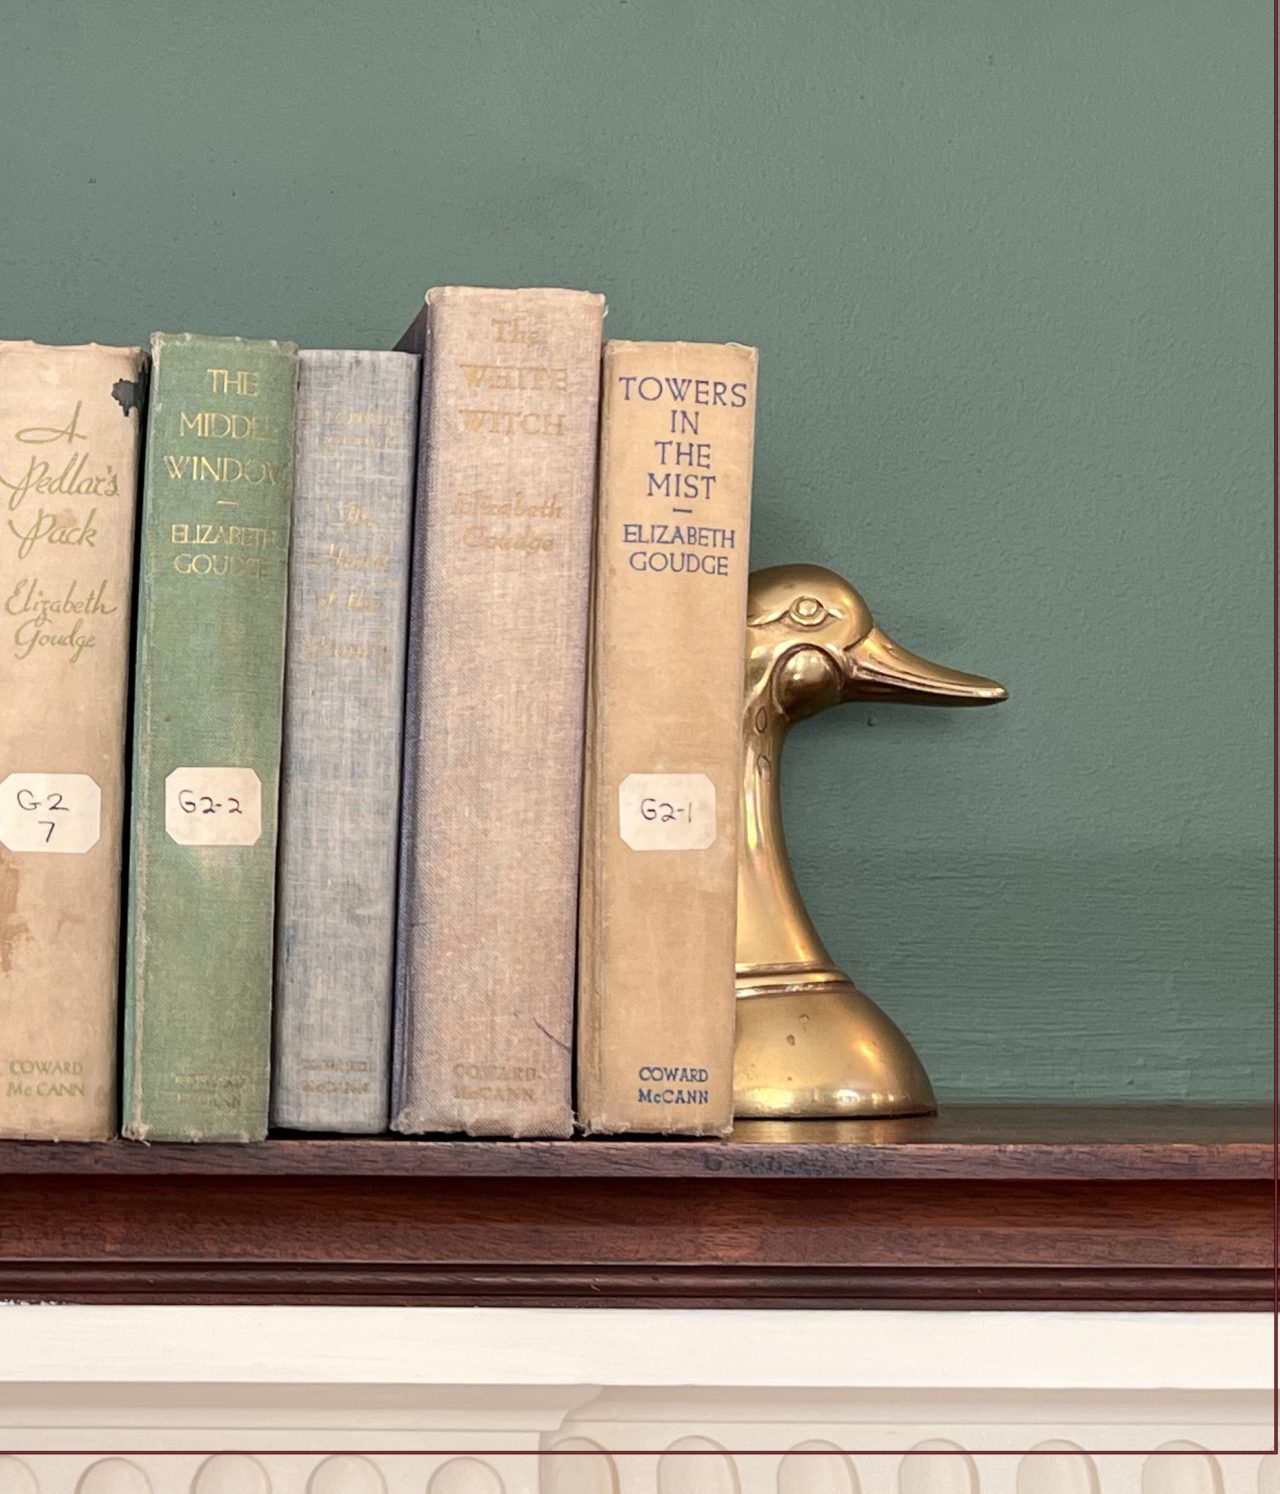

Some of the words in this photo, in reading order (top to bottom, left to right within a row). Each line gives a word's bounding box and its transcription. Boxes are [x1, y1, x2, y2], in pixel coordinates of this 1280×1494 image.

[207, 368, 259, 396] THE
[459, 364, 569, 392] WHITE
[619, 375, 748, 409] TOWERS
[15, 400, 88, 445] A
[458, 408, 567, 437] WITCH
[670, 409, 700, 436] IN
[654, 440, 712, 470] THE
[646, 473, 717, 501] MIST
[7, 507, 99, 560] Pack
[171, 523, 278, 549] ELIZABETH
[623, 522, 737, 550] ELIZABETH
[173, 553, 271, 578] GOUDGE
[628, 551, 729, 577] GOUDGE
[4, 577, 118, 624] Elizabeth
[14, 617, 97, 664] Goudge
[37, 820, 57, 843] 7
[9, 1060, 84, 1076] COWARD
[638, 1065, 709, 1084] COWARD
[637, 1087, 710, 1105] McCANN
